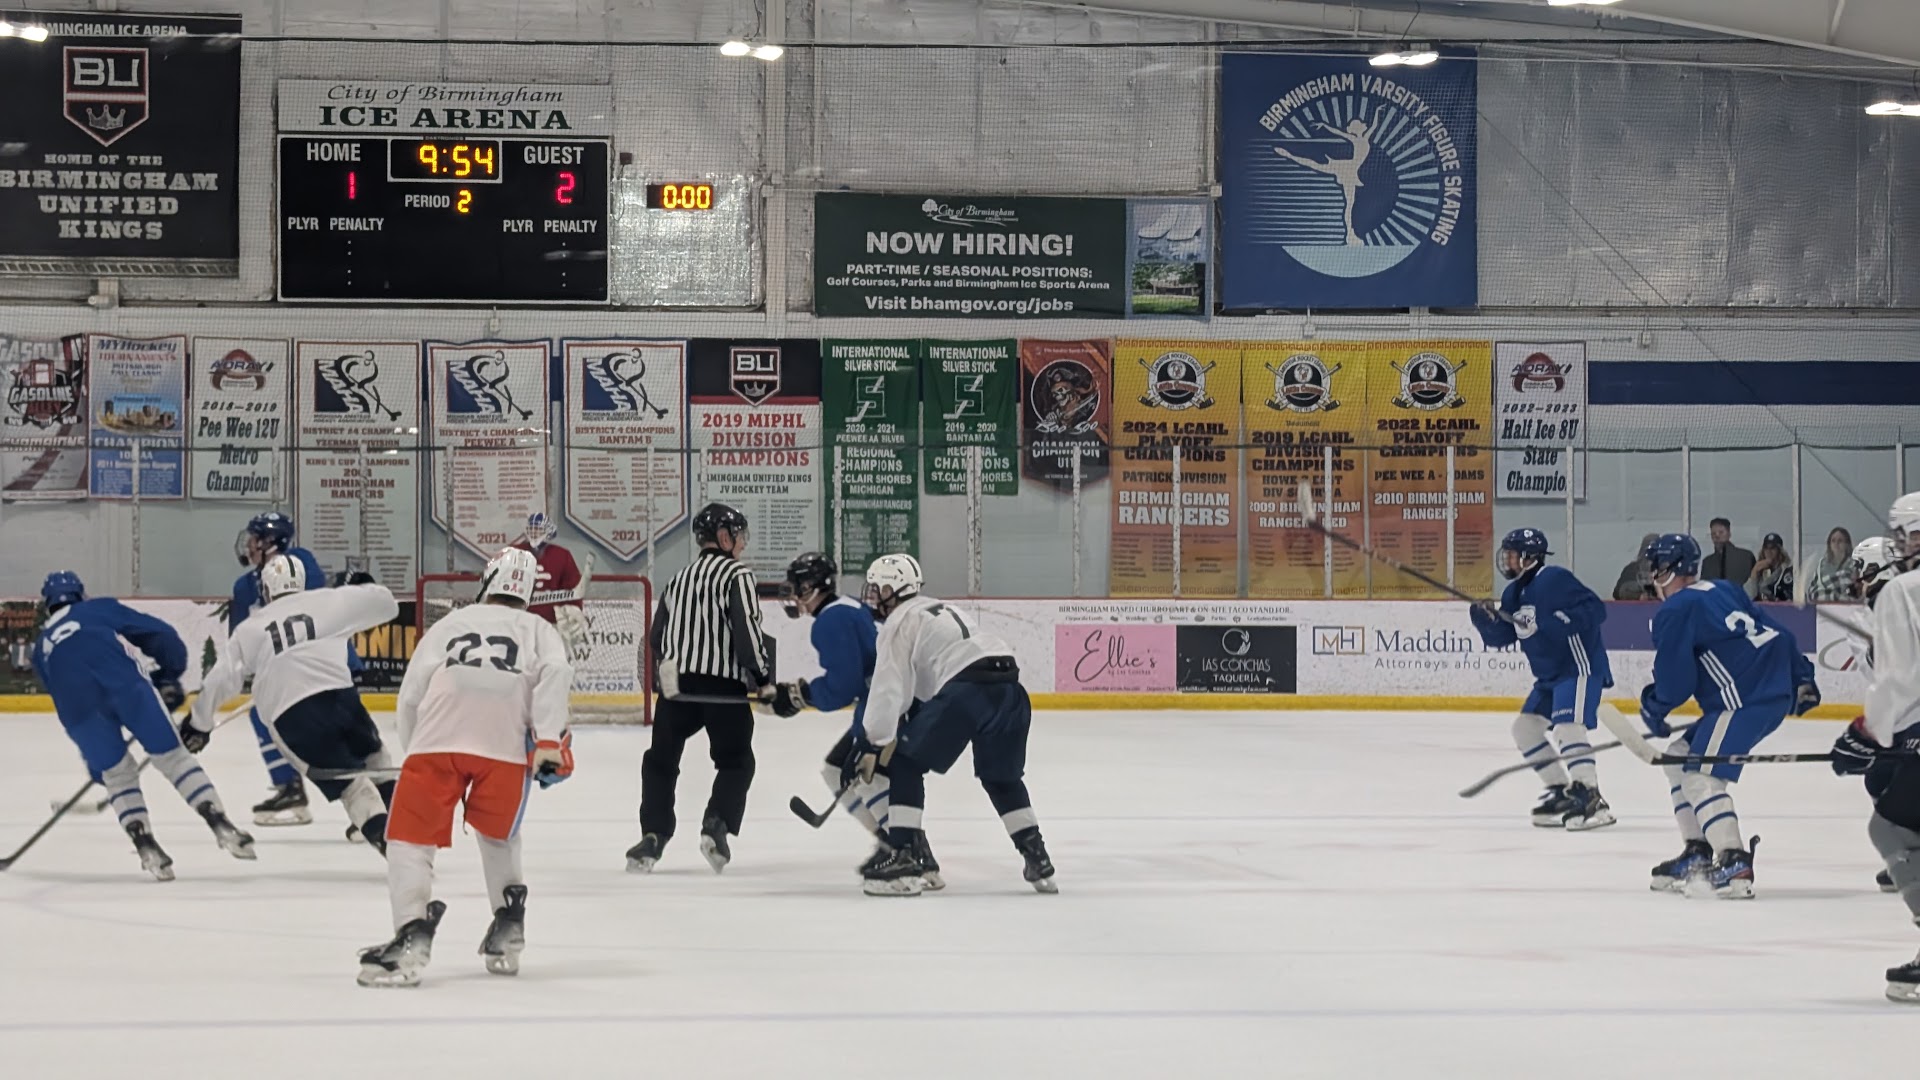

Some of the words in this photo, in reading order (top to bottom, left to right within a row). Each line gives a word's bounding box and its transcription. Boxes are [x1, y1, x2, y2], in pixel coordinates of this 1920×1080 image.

[119, 25, 139, 35] ICE
[143, 25, 187, 36] ARENA
[73, 58, 139, 87] BU
[327, 85, 382, 102] City
[386, 86, 414, 102] of
[418, 86, 564, 106] Birmingham
[1259, 73, 1354, 132] BIRMINGHAM
[1361, 74, 1429, 118] VARSITY
[319, 106, 398, 127] ICE
[411, 108, 572, 130] ARENA
[1422, 114, 1460, 171] FIGURE
[306, 142, 361, 162] HOME
[523, 146, 584, 165] GUEST
[45, 154, 92, 164] HOME
[98, 155, 119, 165] OF
[127, 156, 163, 166] THE
[419, 145, 494, 176] 9:54
[0, 170, 218, 190] BIRMINGHAM
[348, 172, 356, 200] 1
[556, 173, 575, 204] 2
[38, 195, 179, 215] UNIFIED
[404, 194, 451, 209] PERIOD
[457, 190, 472, 213] 2
[938, 204, 954, 217] City
[956, 203, 965, 216] of
[966, 204, 1015, 217] Birmingham
[1431, 175, 1462, 246] SKATING
[58, 220, 163, 239] KINGS
[288, 216, 319, 231] PLYR
[329, 217, 384, 232] PENALTY
[503, 219, 534, 233] PLYR
[544, 219, 598, 234] PENALTY
[866, 231, 944, 255] NOW
[952, 233, 1073, 256] HIRING!
[846, 264, 920, 276] PART-TIME
[932, 265, 1010, 278] SEASONAL
[1012, 266, 1092, 279] POSITIONS:
[827, 277, 849, 287] Golf
[851, 278, 898, 289] Courses,
[901, 278, 931, 288] Parks
[933, 278, 953, 288] and
[955, 279, 1018, 291] Birmingham
[1020, 280, 1037, 289] Ice
[1039, 280, 1075, 291] Sports
[1078, 281, 1110, 290] Arena
[865, 296, 907, 311] Visit
[910, 297, 1073, 314] bhamgov.org/jobs
[98, 339, 177, 352] MYHockey
[832, 346, 910, 358] INTERNATIONAL
[930, 347, 1008, 359] INTERNATIONAL
[736, 354, 774, 372] BU
[844, 360, 872, 371] SILVER
[873, 360, 897, 371] STICK
[942, 360, 970, 372] SILVER
[9, 386, 74, 403] GASOLINE
[198, 417, 221, 437] Pee
[226, 417, 252, 438] Wee
[255, 418, 279, 439] 12U
[702, 413, 743, 428] 2019
[747, 413, 806, 428] MIPHL
[945, 423, 965, 432] 2019
[977, 423, 997, 432] 2020
[1123, 421, 1167, 433] 2024
[1173, 422, 1228, 435] LCAHL
[1377, 419, 1420, 430] 2022
[1426, 419, 1480, 430] LCAHL
[303, 427, 345, 435] DISTRICT
[846, 424, 865, 433] 2020
[877, 424, 896, 433] 2021
[1502, 419, 1532, 439] Half
[1534, 420, 1556, 439] Ice
[1559, 419, 1579, 439] 8U
[464, 438, 504, 446] PEEWEE
[509, 438, 516, 446] A
[599, 436, 642, 444] BANTAM
[712, 432, 796, 447] DIVISION
[836, 434, 867, 443] PEEWEE
[869, 435, 879, 443] AA
[881, 435, 905, 443] SILVER
[946, 434, 981, 442] BANTAM
[984, 433, 996, 441] AA
[1139, 435, 1213, 447] PLAYOFF
[1252, 432, 1293, 443] 2019
[1299, 432, 1354, 443] LCAHL
[1394, 432, 1465, 443] PLAYOFF
[219, 444, 258, 465] Metro
[700, 450, 810, 466] HAMPIONS
[847, 447, 896, 458] REGIONAL
[1380, 445, 1478, 457] CHAMPINS
[1523, 445, 1558, 465] State
[840, 460, 903, 472] CHAMPIONS
[207, 470, 269, 495] Champion
[753, 473, 786, 483] UNIFIED
[788, 473, 812, 483] KINGS
[876, 475, 912, 484] SHORES
[1123, 471, 1173, 482] PATRICK
[1179, 472, 1226, 483] DIVISION
[1263, 475, 1297, 485] HOWE
[1375, 470, 1397, 480] PEE
[1400, 470, 1424, 480] WEE
[1428, 470, 1435, 480] A
[1446, 470, 1484, 480] DAMS
[720, 485, 730, 494] JV
[732, 485, 764, 494] HOCKEY
[766, 485, 789, 494] TEAM
[849, 485, 894, 495] MICHIGAN
[1507, 471, 1568, 495] Champio
[1263, 488, 1282, 497] DIV
[1334, 488, 1341, 497] A
[1375, 493, 1403, 504] 2010
[1249, 502, 1275, 512] 2009
[477, 533, 507, 544] 2021
[612, 530, 641, 541] 2021
[264, 613, 316, 656] 10
[1724, 611, 1779, 649] 2
[1321, 632, 1356, 650] MH
[1375, 629, 1473, 652] Maddin
[1074, 629, 1157, 683] Ellie's
[1202, 658, 1218, 672] LAS
[1220, 657, 1271, 672] CONCHAS
[1375, 658, 1448, 671] Attorneys
[1454, 657, 1481, 669] and
[1729, 754, 1799, 765] CCM
